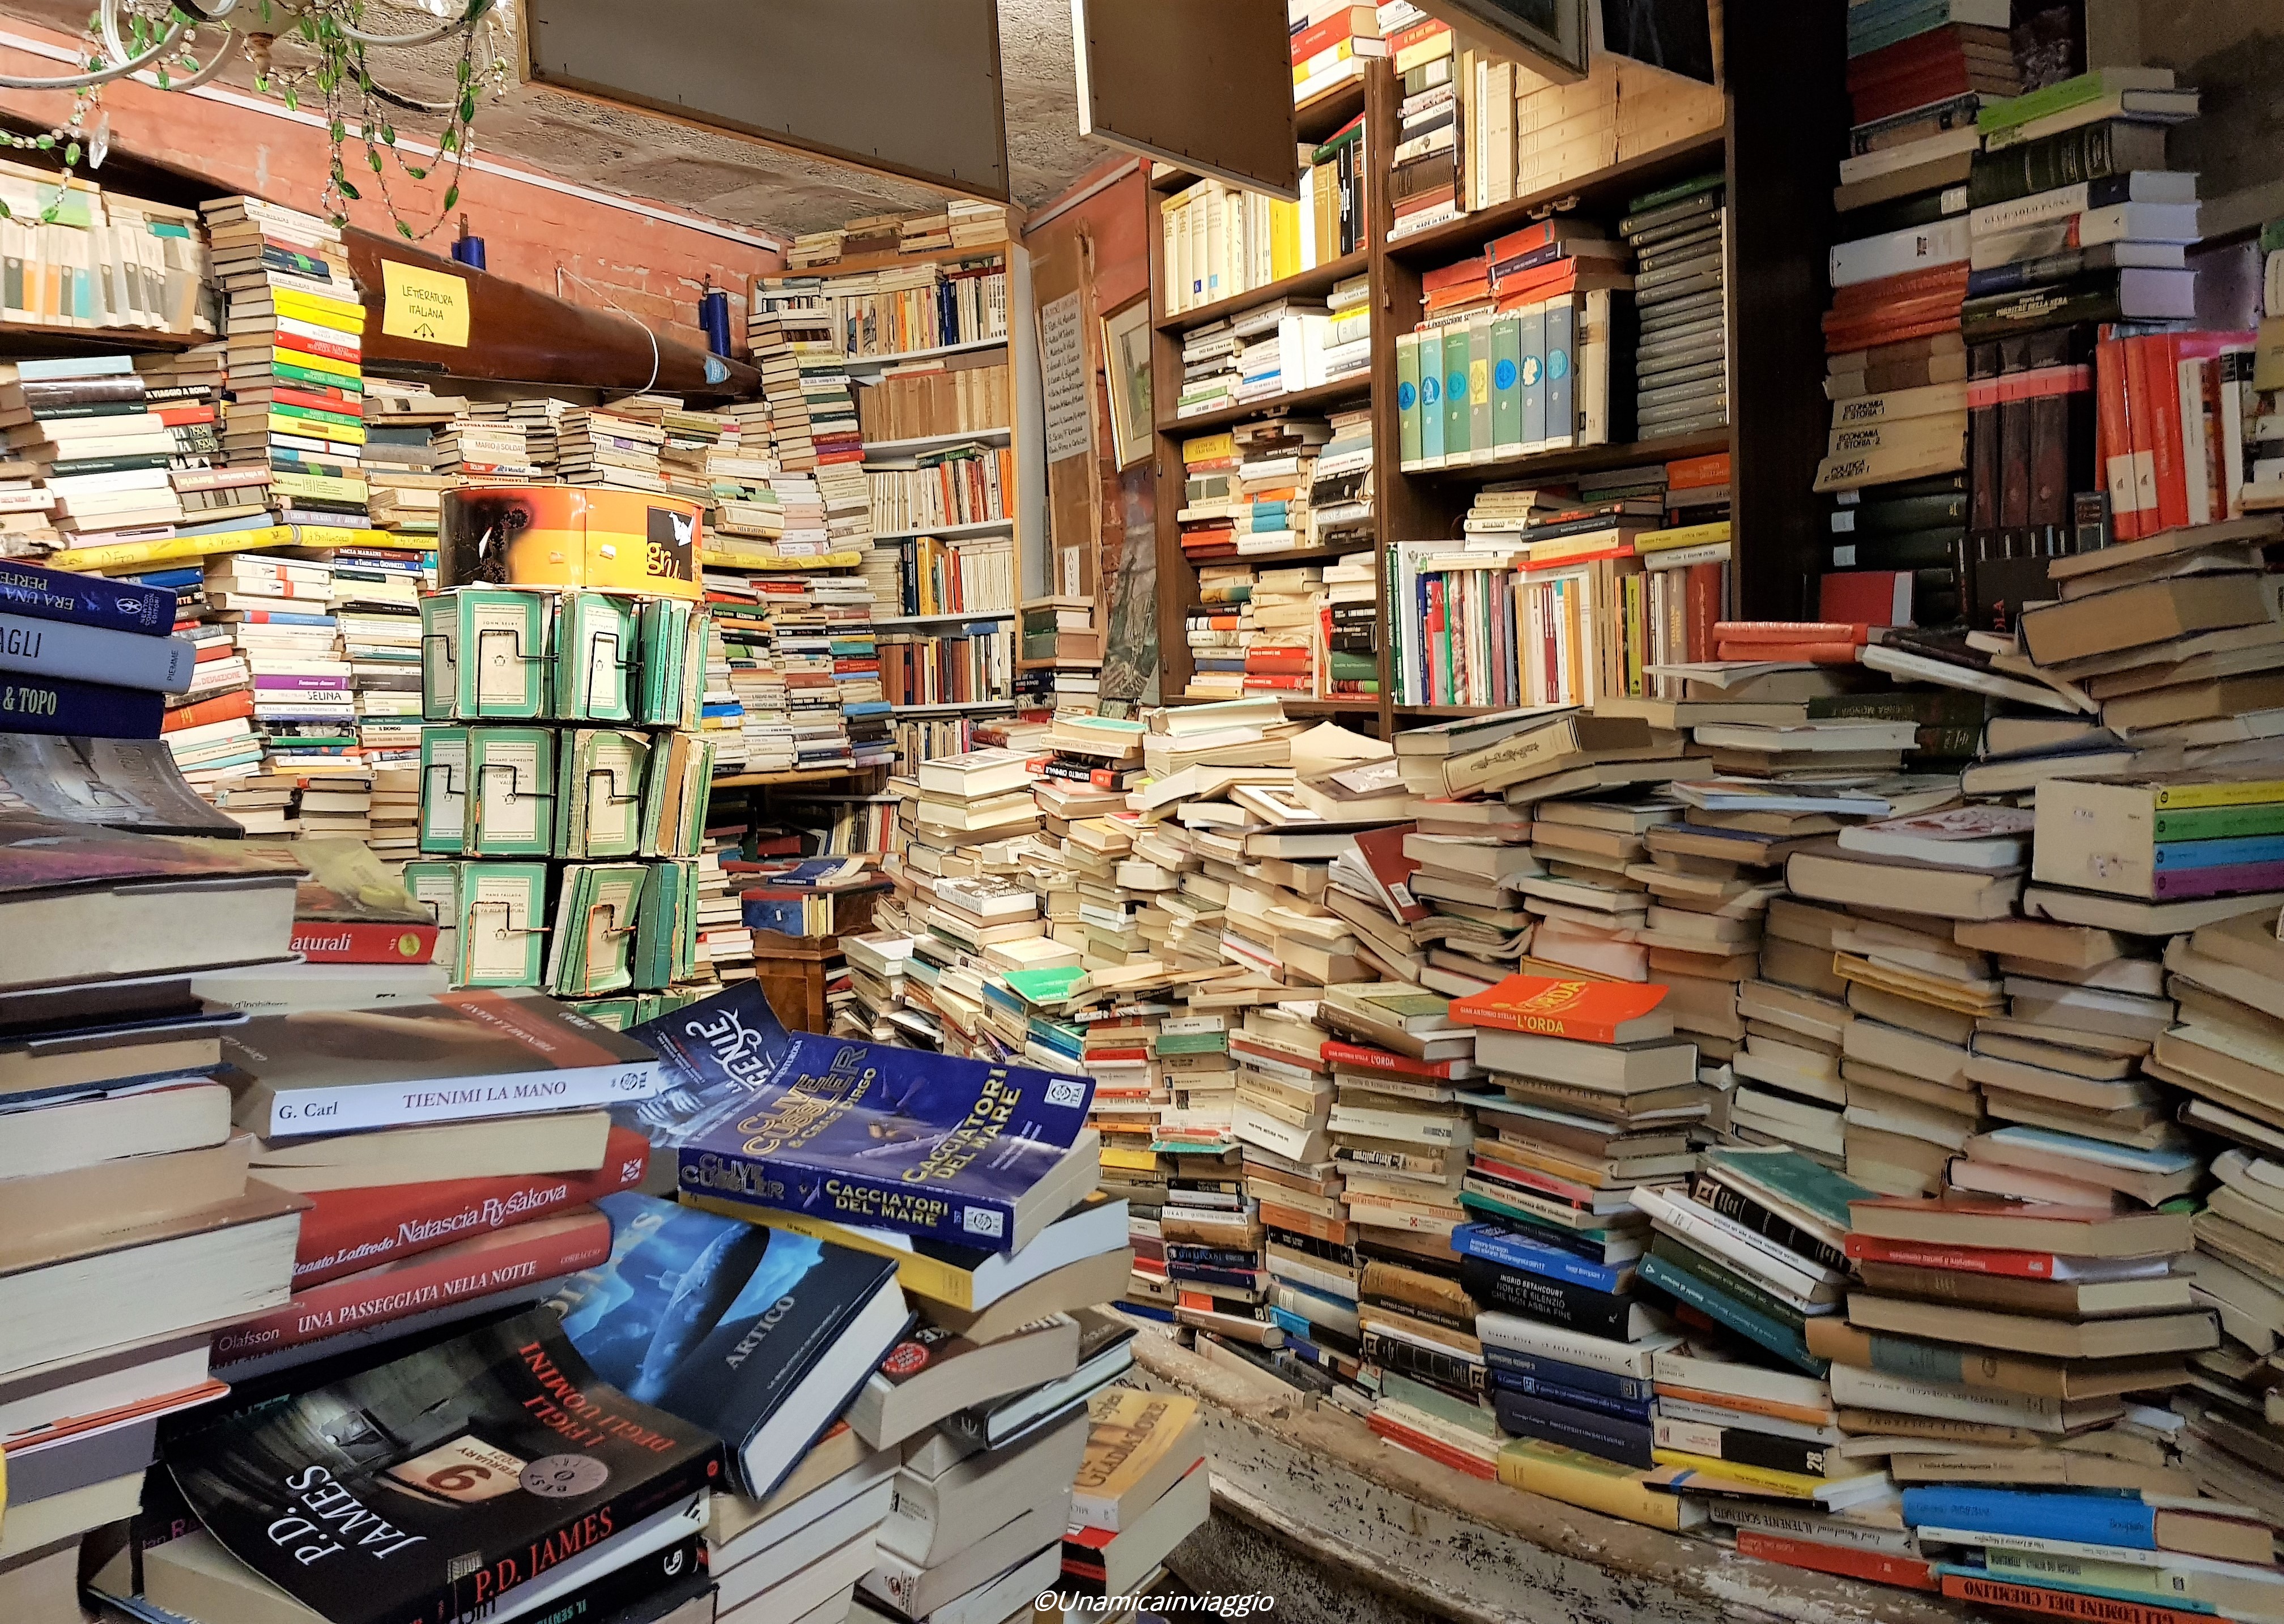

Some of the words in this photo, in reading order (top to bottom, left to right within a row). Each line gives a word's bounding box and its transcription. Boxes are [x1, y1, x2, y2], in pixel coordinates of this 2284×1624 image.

[1439, 214, 1450, 222] USA
[402, 285, 453, 306] LETTERATURA
[151, 388, 181, 398] VIAGGIO
[188, 386, 211, 395] ROMA
[190, 426, 207, 438] 1934
[195, 438, 214, 450] 1934
[5, 587, 38, 604] UNA
[44, 595, 75, 611] ERA
[167, 650, 179, 681] PIEMME
[201, 671, 241, 685] DEVIAZIONE
[3, 686, 14, 710] &
[19, 687, 57, 716] TOPO
[307, 691, 342, 701] SELINA
[1473, 1008, 1496, 1018] ANTONIO
[1497, 1012, 1516, 1021] STELLA
[1516, 1015, 1564, 1034] L'ORDA
[1371, 1055, 1395, 1067] L'ORDA
[279, 1104, 297, 1120] G.
[304, 1102, 338, 1118] Carl
[403, 1090, 482, 1110] TIENIMI
[486, 1087, 508, 1103] LA
[512, 1081, 567, 1099] MANO
[738, 1074, 819, 1133] CLIVE
[742, 1046, 868, 1156] CUSSLER
[840, 1068, 877, 1110] DIRGO
[902, 1067, 1008, 1184] CACCIATORI
[931, 1141, 976, 1180] DEL
[972, 1086, 1022, 1146] MARE
[681, 1165, 785, 1200] CUSSLER
[825, 1179, 949, 1217] CACCIATORI
[835, 1196, 875, 1216] DEL
[881, 1205, 939, 1228] MARE
[335, 1236, 395, 1263] Loffredo
[395, 1206, 478, 1247] Natascia
[480, 1184, 567, 1226] Rysakova
[297, 1310, 334, 1333] UNA
[338, 1285, 438, 1323] PASSEGGIATA
[442, 1272, 487, 1297] NELLA
[490, 1261, 537, 1287] NOTTE
[1496, 1282, 1513, 1294] NON
[1530, 1291, 1566, 1308] SILENZIO
[1500, 1273, 1521, 1287] INGRID
[1522, 1280, 1563, 1299] BETANCOURT
[219, 1328, 280, 1352] Olafsson
[725, 1295, 796, 1370] ARTICO
[517, 1340, 594, 1422] UOMINI
[522, 1395, 586, 1438] FIGLI
[586, 1433, 607, 1448] I
[598, 1412, 677, 1453] DEGLI
[488, 1450, 520, 1468] 2021
[286, 1464, 428, 1559] JAMES
[1764, 1515, 1803, 1533] TENENTE
[267, 1507, 346, 1567] P.D.
[474, 1553, 521, 1604] P.D.
[528, 1507, 615, 1578] JAMES
[1964, 1581, 2041, 1607] CREMLINO
[2045, 1595, 2074, 1613] DEL
